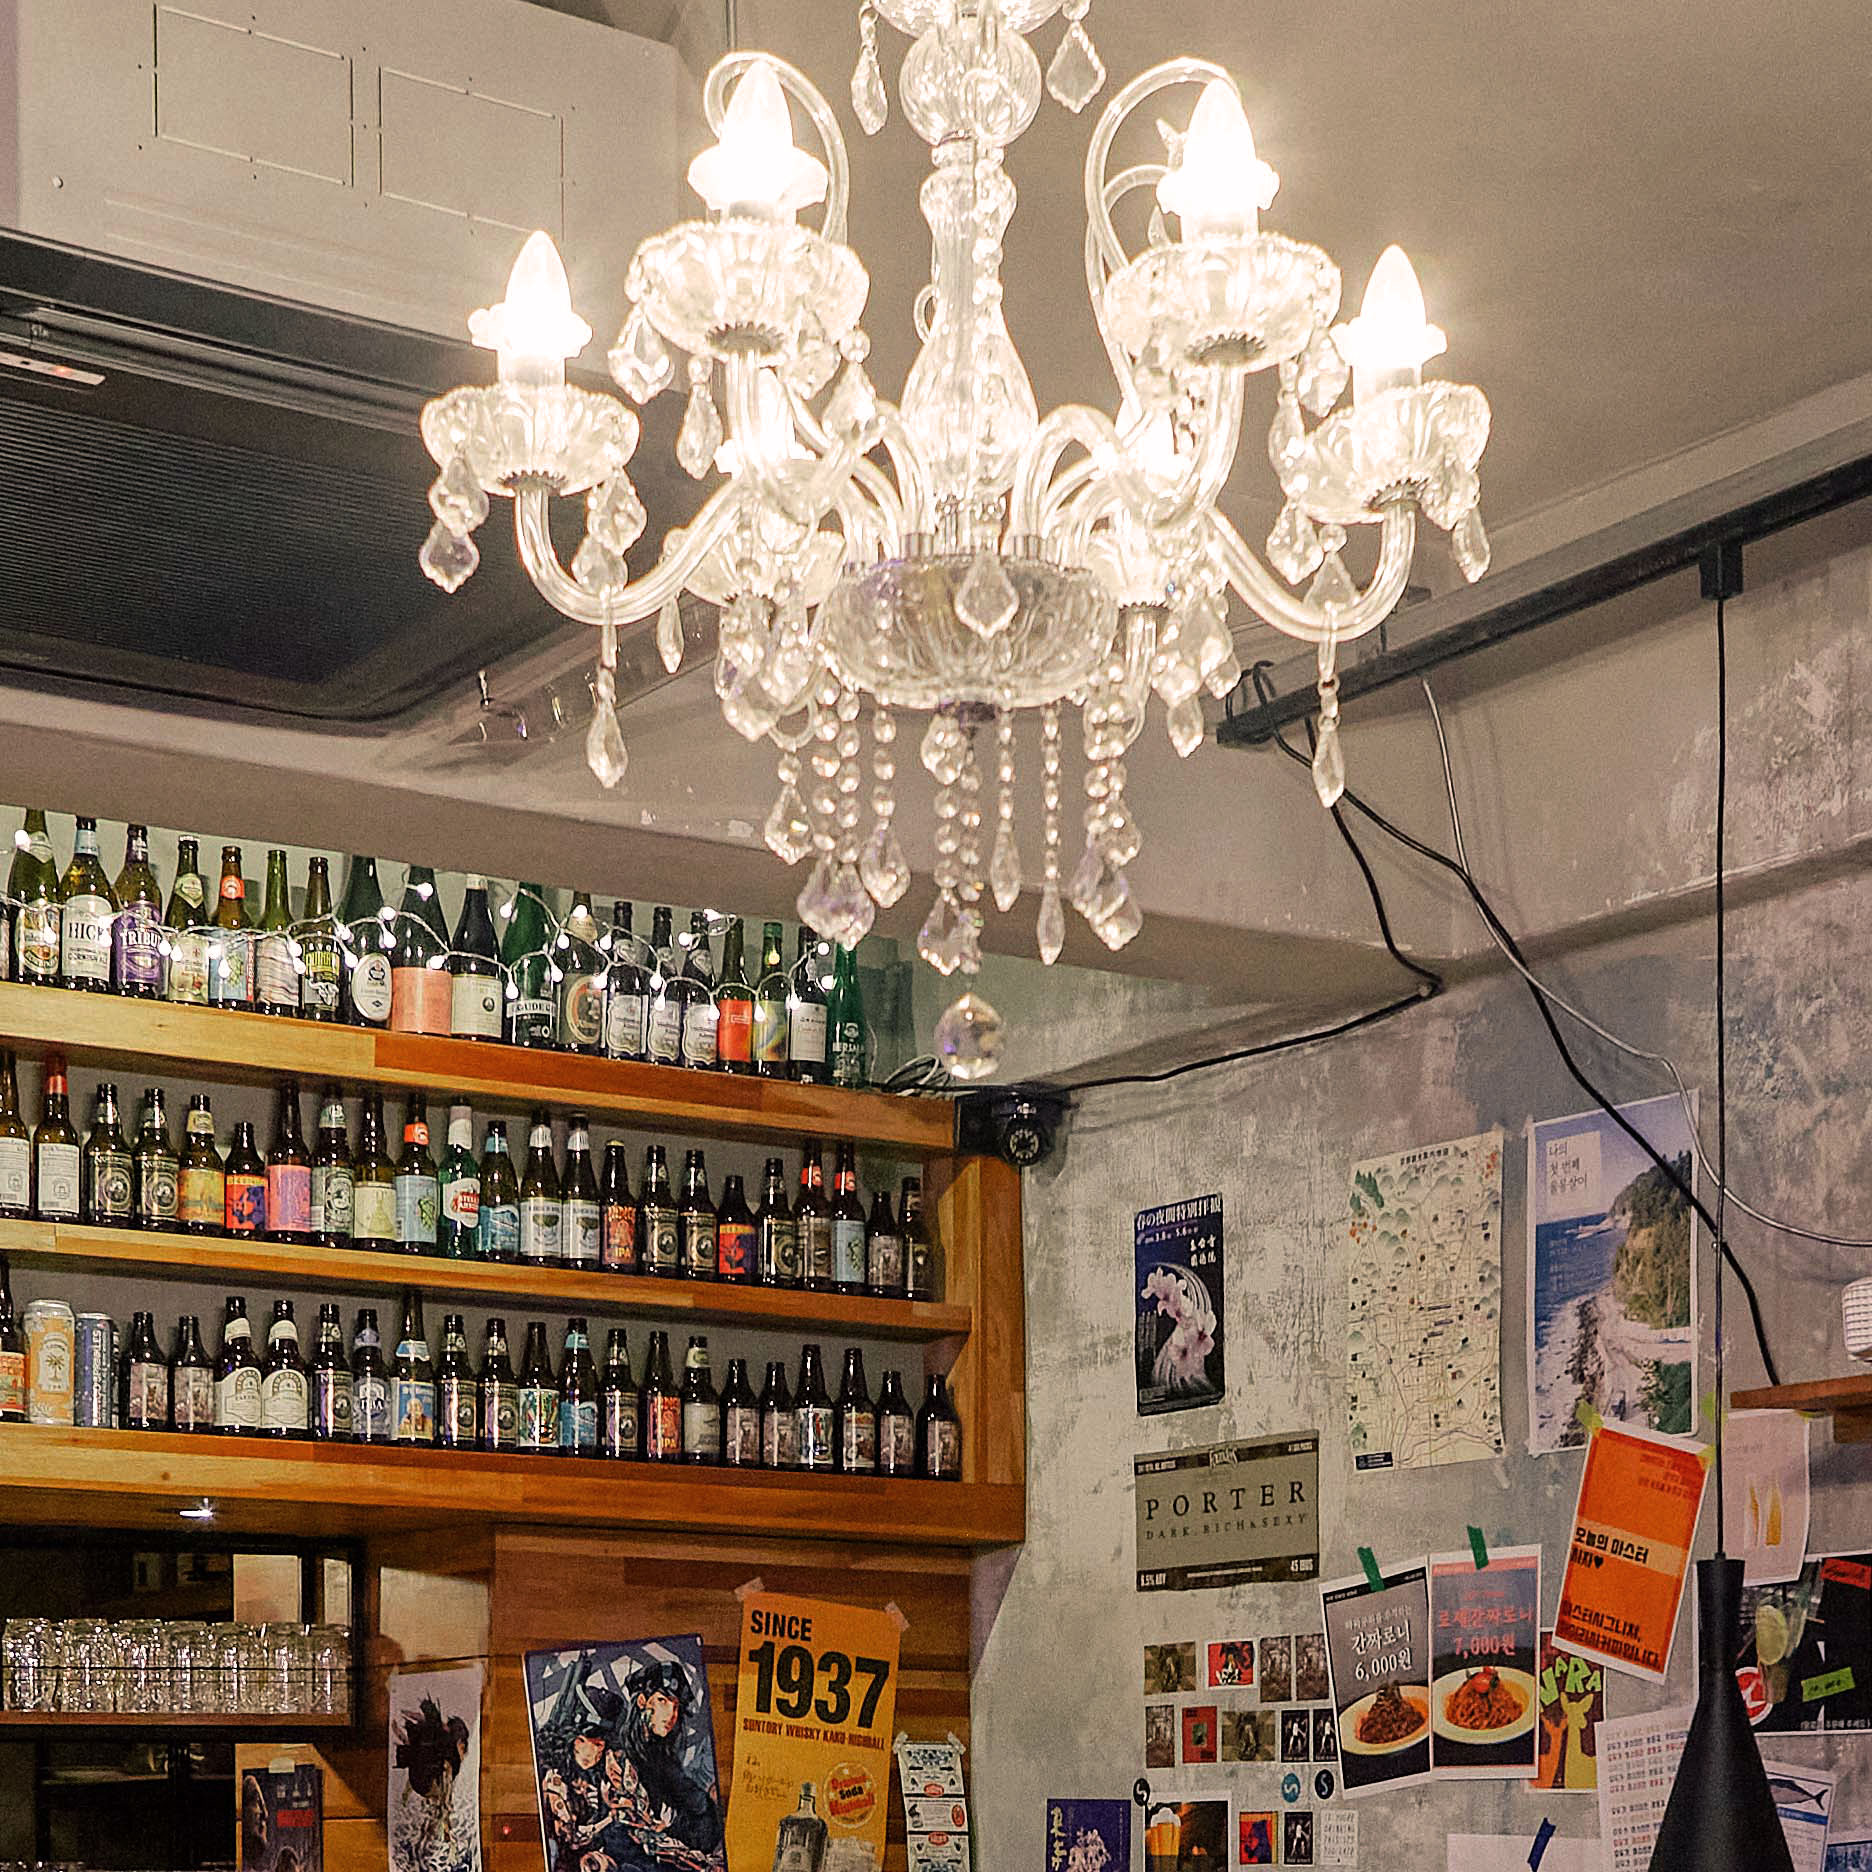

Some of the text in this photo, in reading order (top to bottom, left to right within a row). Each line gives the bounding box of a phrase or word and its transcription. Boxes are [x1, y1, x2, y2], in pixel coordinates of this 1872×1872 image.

[1145, 1481, 1306, 1521] PORTER
[1611, 1538, 1649, 1565] 마스터
[749, 1609, 813, 1642] SINCE
[1352, 1619, 1412, 1655] 간짜로니
[1453, 1633, 1517, 1659] 7,000원
[1355, 1647, 1413, 1682] 6,000원
[748, 1640, 891, 1729] 1937
[742, 1717, 784, 1738] SUNTORY
[786, 1722, 821, 1740] WHISKY
